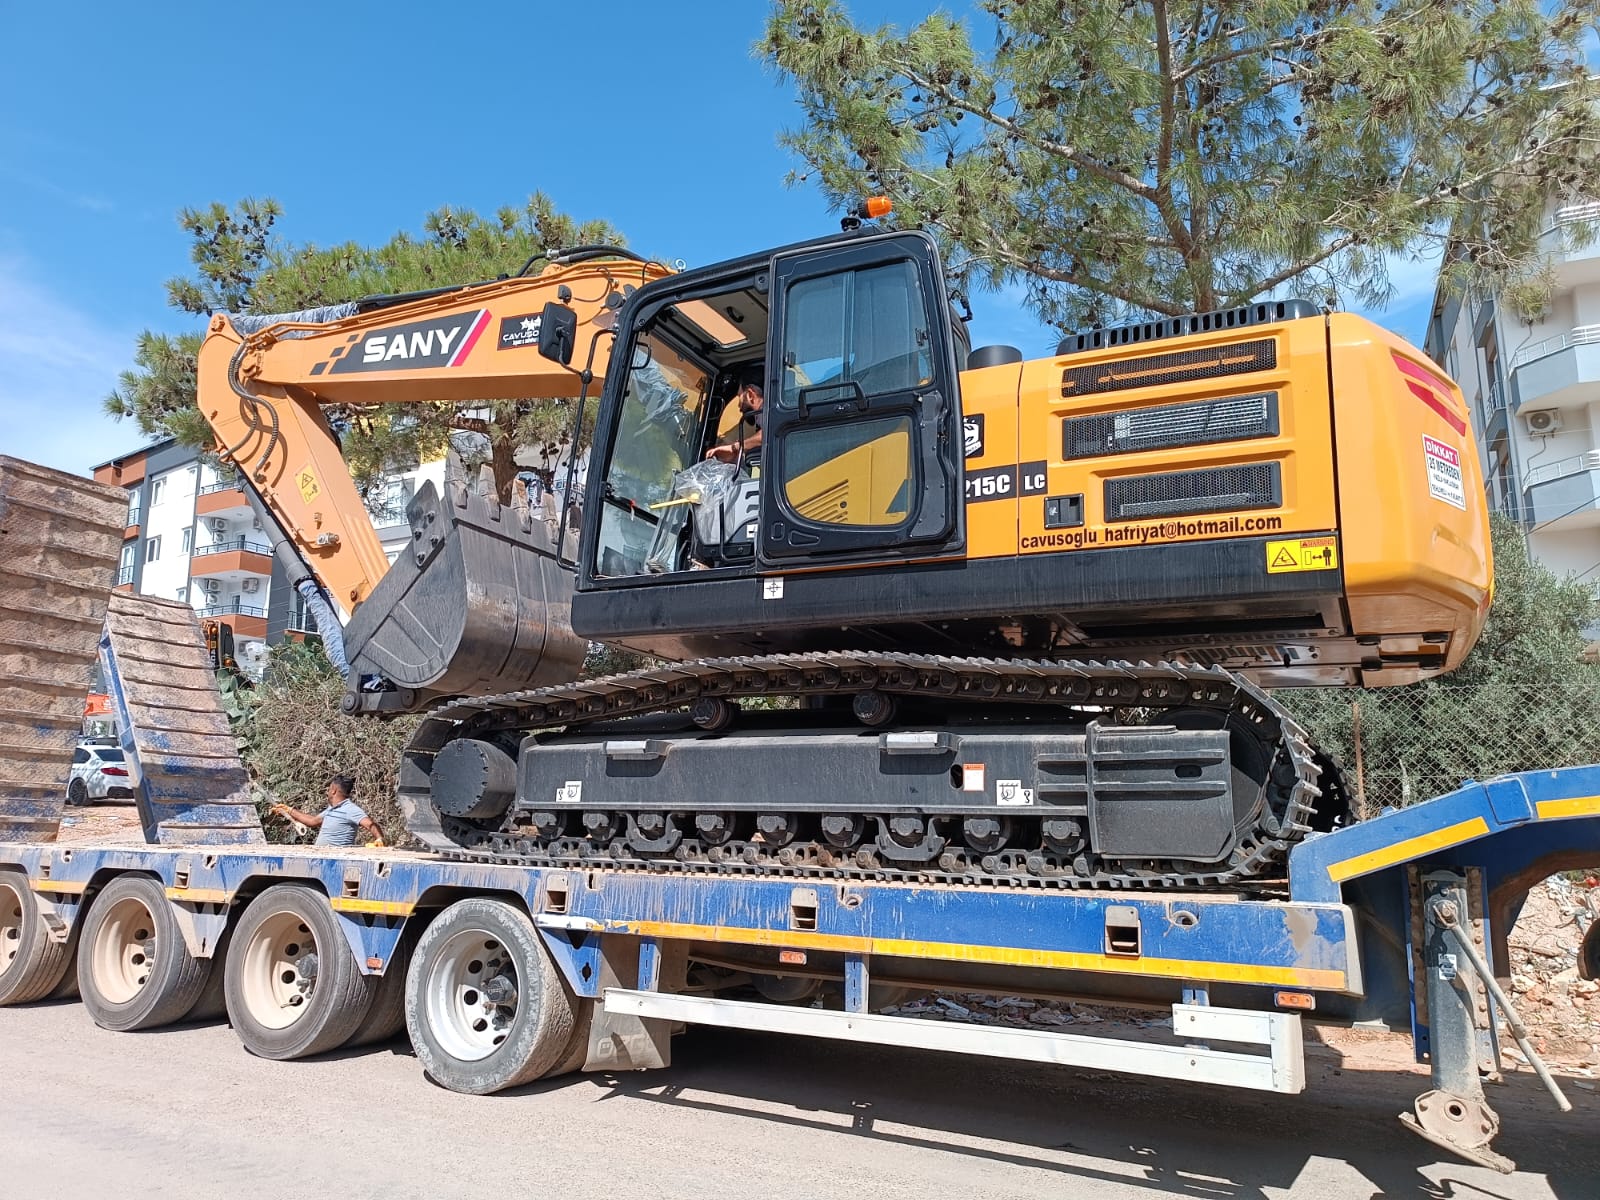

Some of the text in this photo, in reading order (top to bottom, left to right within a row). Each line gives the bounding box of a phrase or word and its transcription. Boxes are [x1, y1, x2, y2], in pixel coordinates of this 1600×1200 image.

[362, 326, 462, 364] SANY
[1024, 474, 1045, 490] LC
[1021, 515, 1282, 549] cavusoglu_hafriyat@hotmail.com
